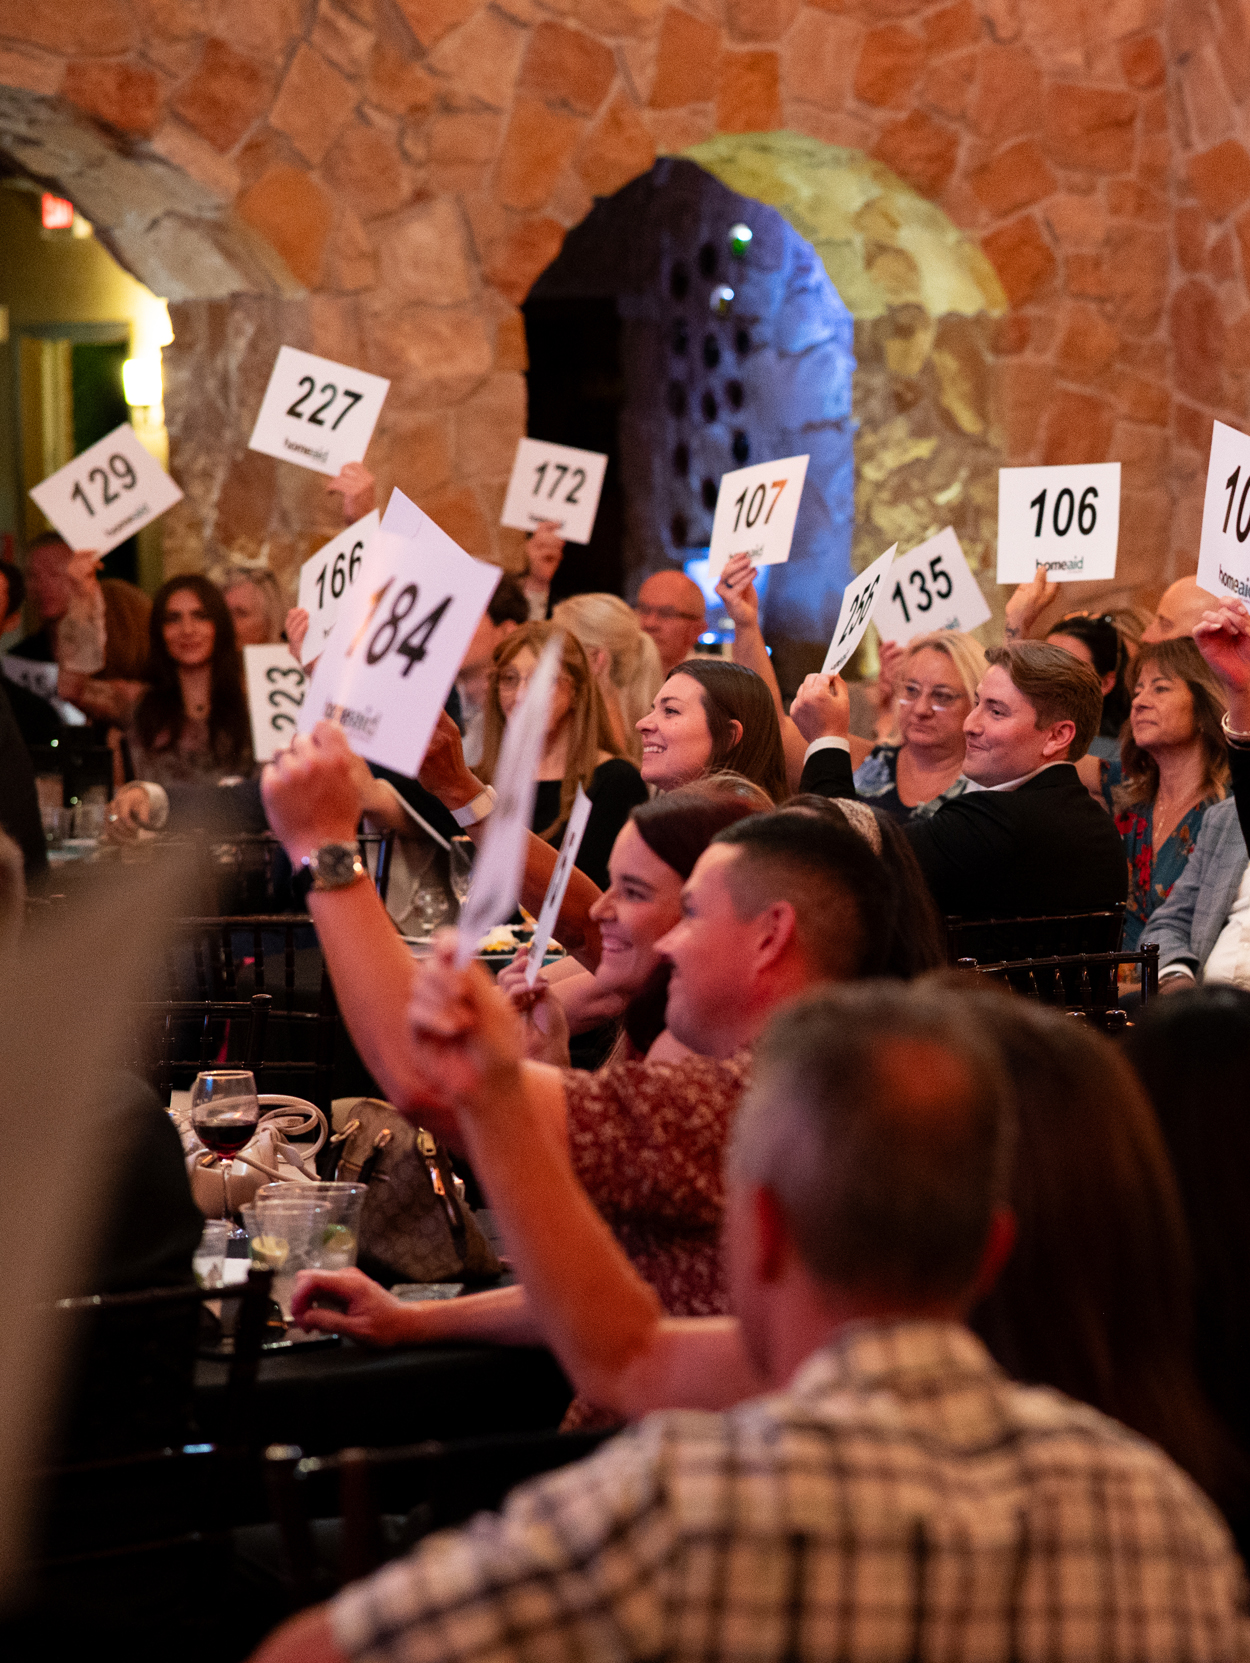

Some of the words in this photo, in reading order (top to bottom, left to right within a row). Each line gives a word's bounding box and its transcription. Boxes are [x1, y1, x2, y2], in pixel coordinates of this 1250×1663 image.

[286, 375, 364, 431] 227
[71, 453, 137, 517] 129
[532, 462, 587, 505] 172
[733, 479, 788, 534] 107
[1029, 485, 1099, 538] 106
[315, 541, 364, 610] 166
[892, 555, 953, 623] 135
[1035, 555, 1084, 573] homeaid
[345, 575, 454, 678] 184
[838, 573, 881, 647] 256
